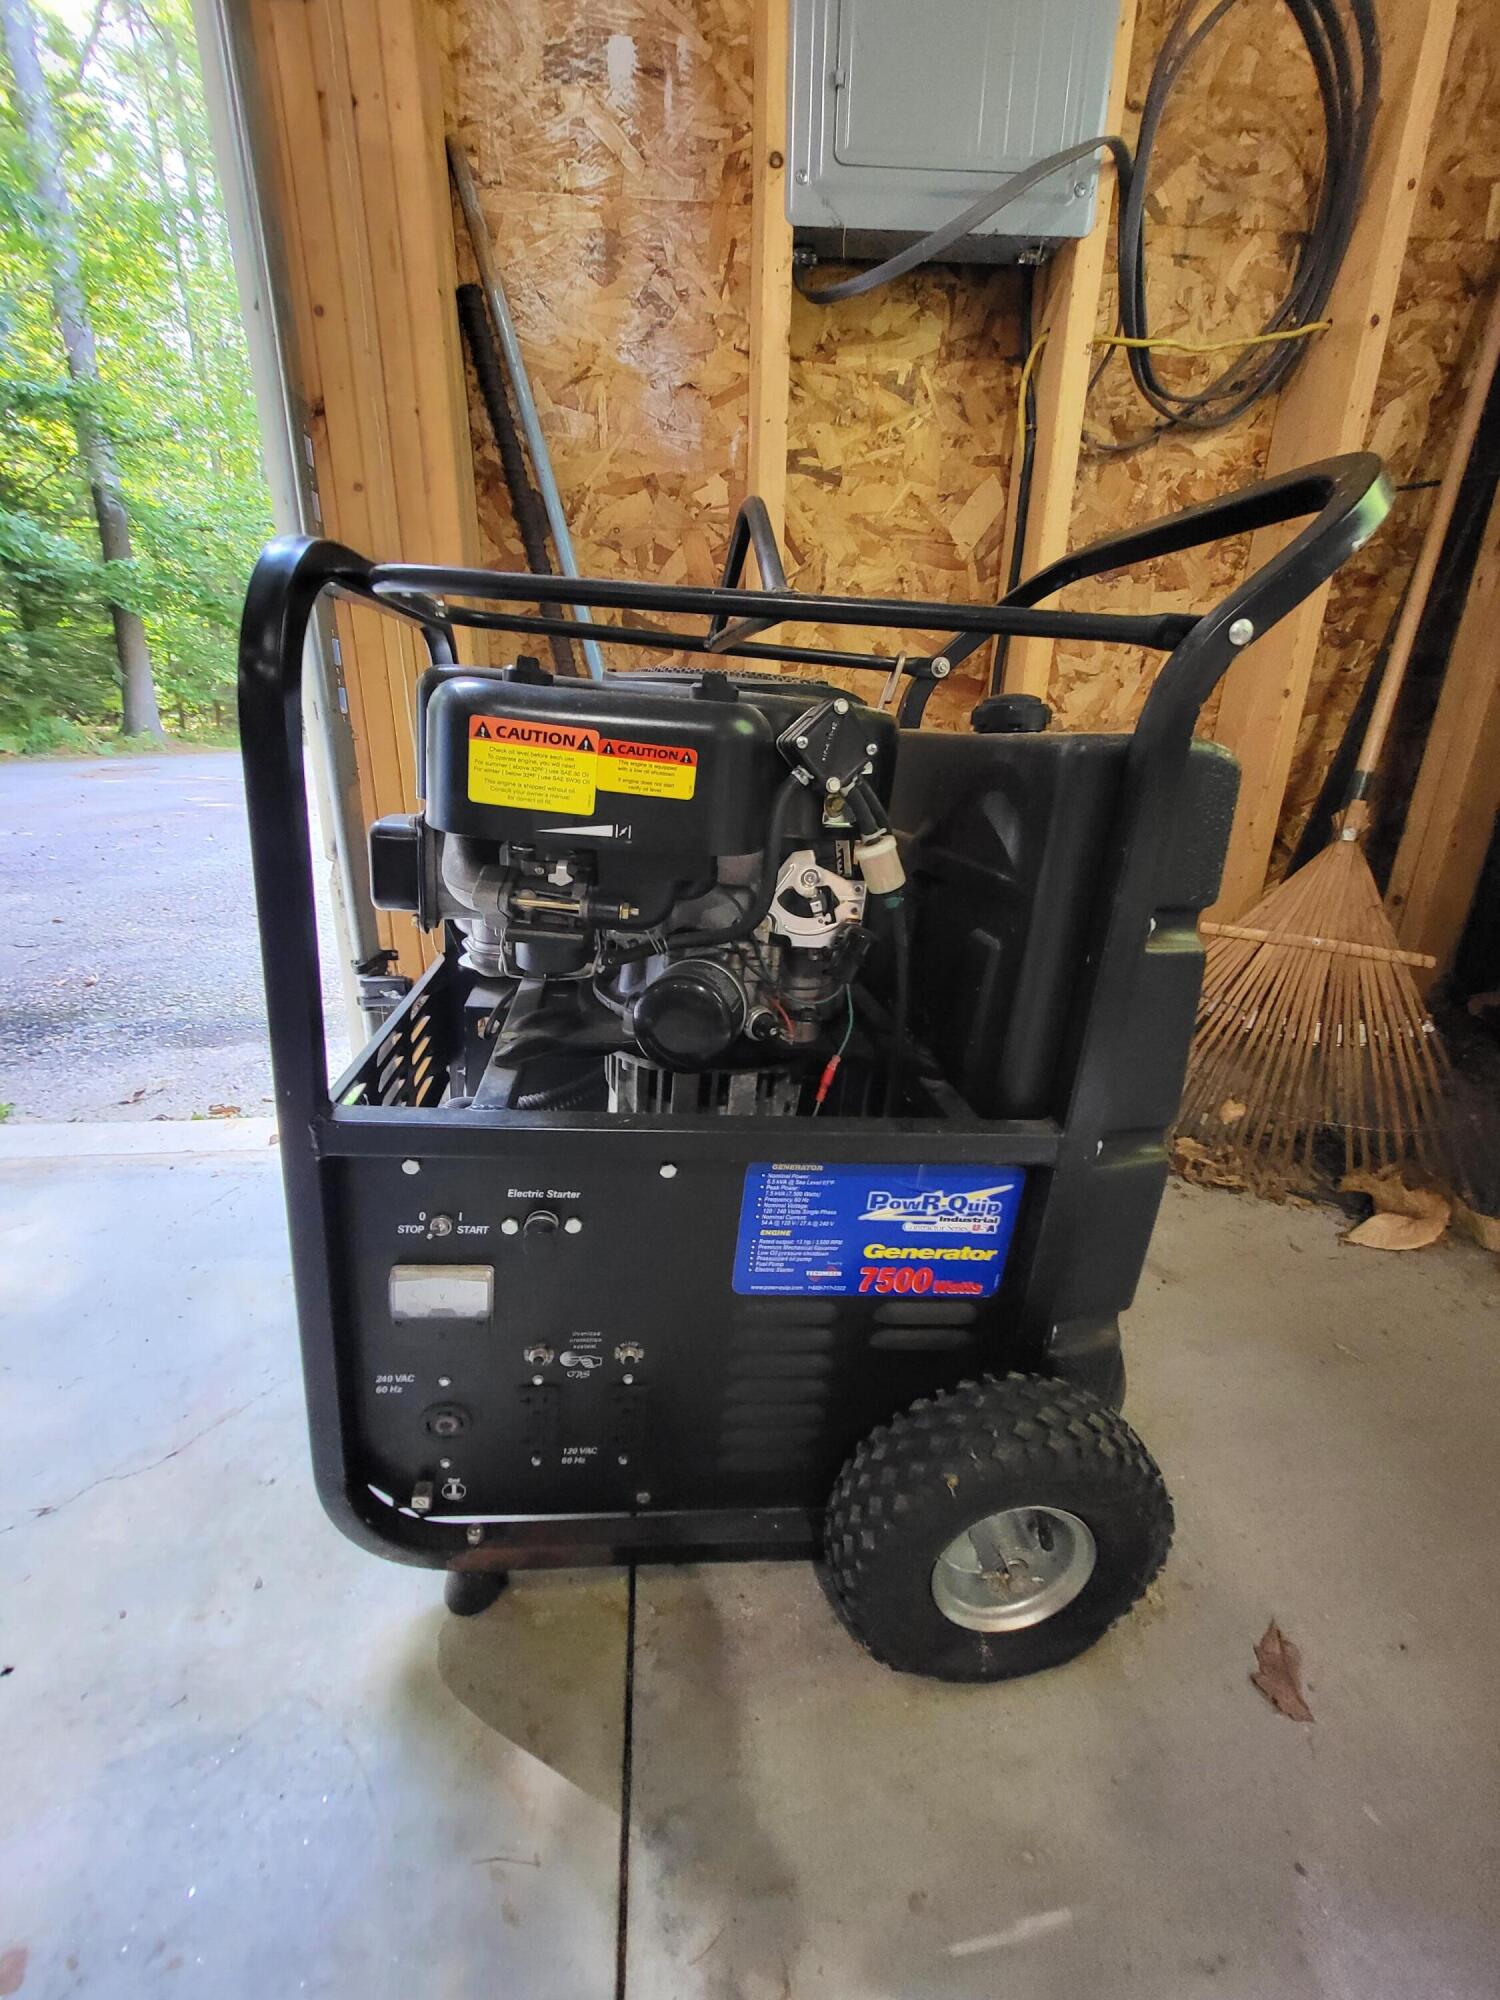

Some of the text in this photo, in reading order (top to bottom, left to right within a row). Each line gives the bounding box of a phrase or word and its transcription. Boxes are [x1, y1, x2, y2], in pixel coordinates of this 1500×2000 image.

[496, 726, 576, 747] CAUTION
[489, 746, 508, 754] Check
[530, 751, 548, 759] before
[618, 744, 679, 760] CAUTION
[523, 782, 546, 791] shipped
[507, 1188, 581, 1199] Electric Starter
[397, 1224, 489, 1234] STOP START
[972, 1224, 995, 1232] UA
[864, 1243, 998, 1261] Generator
[859, 1266, 933, 1294] 7500
[933, 1280, 983, 1294] Watts
[375, 1374, 415, 1383] 240 VAC
[375, 1385, 403, 1394] 60 Hz
[579, 1447, 598, 1455] VAC
[561, 1456, 586, 1464] 60 Hz
